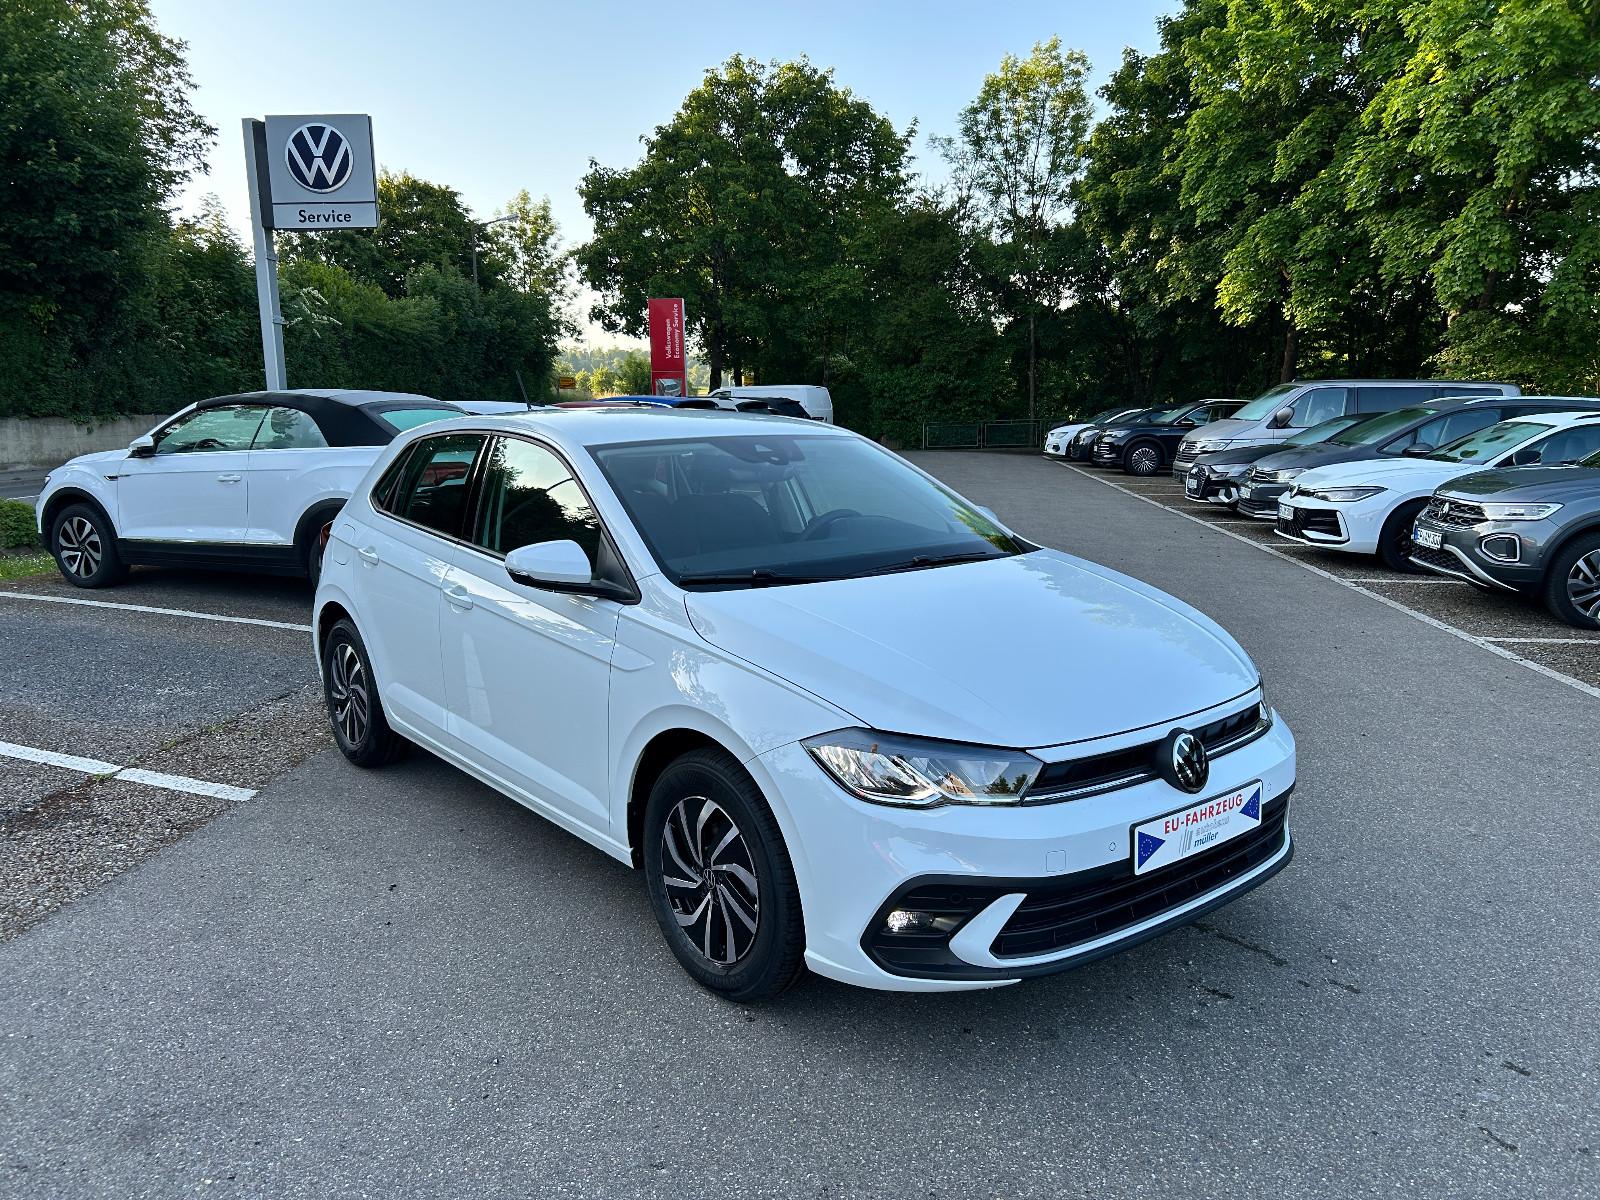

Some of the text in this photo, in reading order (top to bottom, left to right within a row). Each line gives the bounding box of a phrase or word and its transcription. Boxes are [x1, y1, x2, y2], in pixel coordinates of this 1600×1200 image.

[298, 209, 352, 223] Service
[665, 318, 673, 359] Volkswagen
[672, 303, 681, 359] Economy Service
[1163, 793, 1243, 835] EU-FAHRZEUG
[1193, 831, 1219, 847] müller
